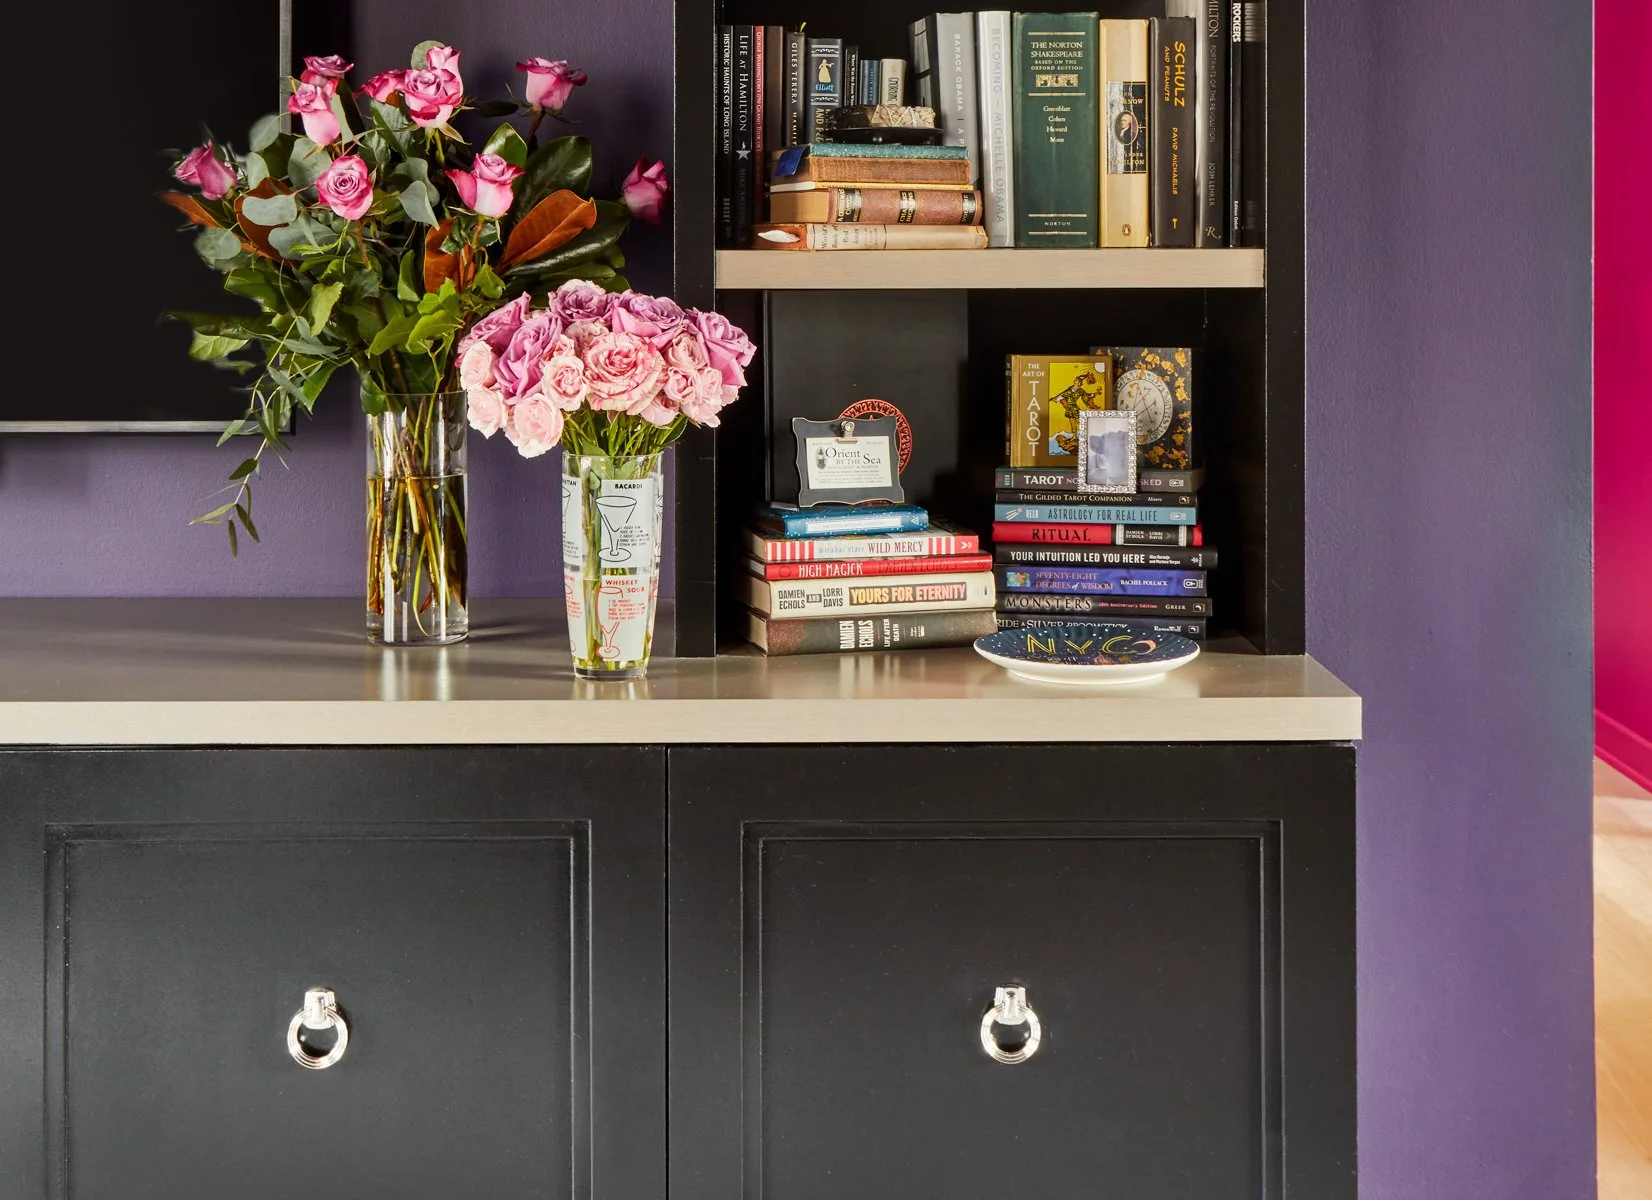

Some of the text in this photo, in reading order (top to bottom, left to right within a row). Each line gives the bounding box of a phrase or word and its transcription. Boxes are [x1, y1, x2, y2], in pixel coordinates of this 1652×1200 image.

[1232, 3, 1241, 42] ROCKERS
[1174, 41, 1185, 107] SCHULZ
[740, 35, 748, 131] LIFE HAMILTON
[723, 96, 730, 106] OF
[992, 28, 1005, 223] BECOMING MICHELLE OBAMA
[1026, 380, 1041, 457] TAROT
[825, 447, 861, 458] Orient
[863, 454, 881, 464] Sea
[1024, 475, 1064, 484] TAROT
[1048, 509, 1158, 521] ASTROLOGY FOR REAL LIFE
[1032, 528, 1091, 541] RITUAL
[868, 541, 923, 554] WILD MERCY
[1011, 552, 1145, 564] YOUR INTUITION LED YOU HERE
[798, 562, 863, 577] HIGH MAGICK
[1036, 572, 1098, 580] SEVENTY-EIGHT
[778, 588, 843, 599] DAMIEN LORRI
[851, 583, 966, 604] YOURS FOR ETERNITY
[780, 598, 843, 610] ECHOLS DAVIS
[1006, 597, 1092, 610] MONSTERS
[839, 620, 855, 649] DAMIEN
[858, 620, 874, 648] ECHOLS
[1026, 634, 1133, 654] NYC
